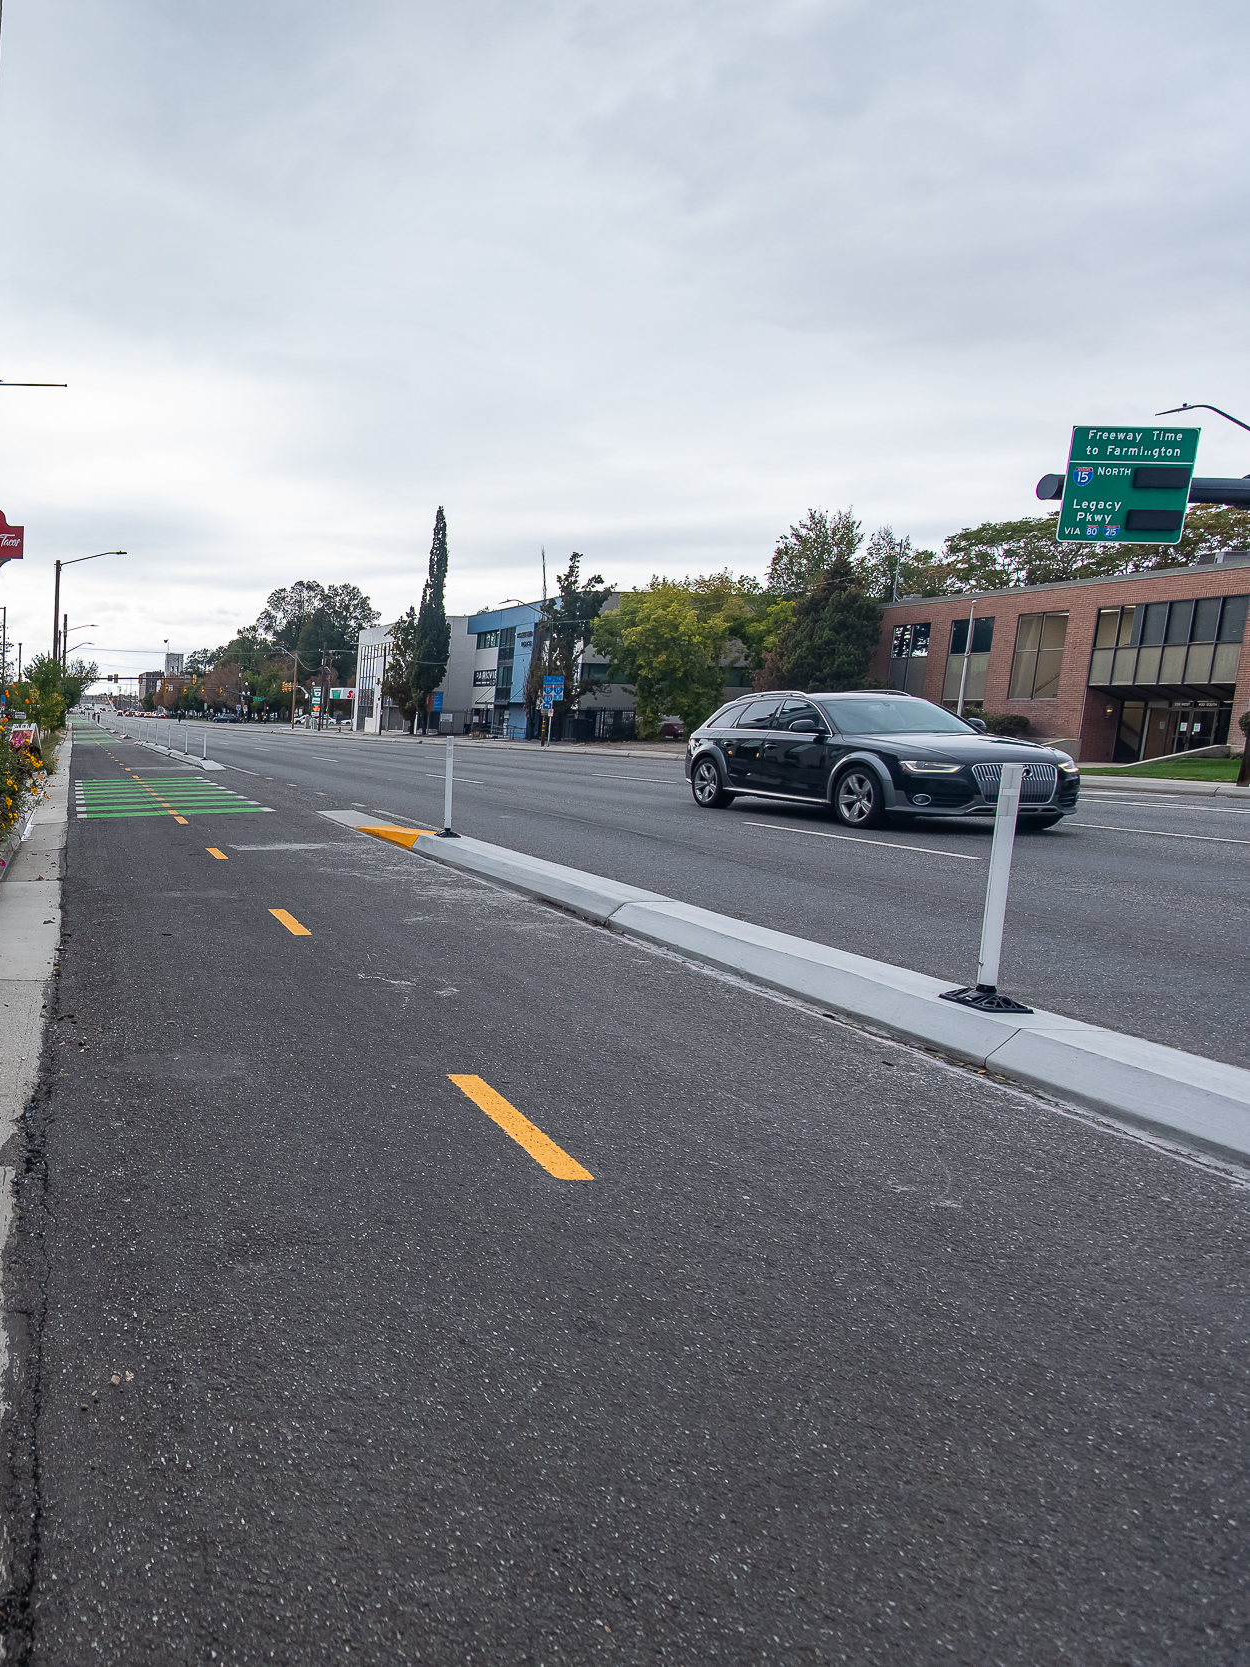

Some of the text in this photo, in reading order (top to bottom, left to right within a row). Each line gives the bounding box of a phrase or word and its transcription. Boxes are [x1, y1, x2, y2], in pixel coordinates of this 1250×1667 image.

[1088, 429, 1183, 443] Freeway Time
[1086, 446, 1099, 455] to
[1077, 466, 1132, 483] 15 NORTH
[1073, 498, 1122, 511] Legacy
[1076, 511, 1112, 524] Pkwy
[1064, 527, 1117, 536] VIA 80 215
[0, 533, 21, 547] Tacos
